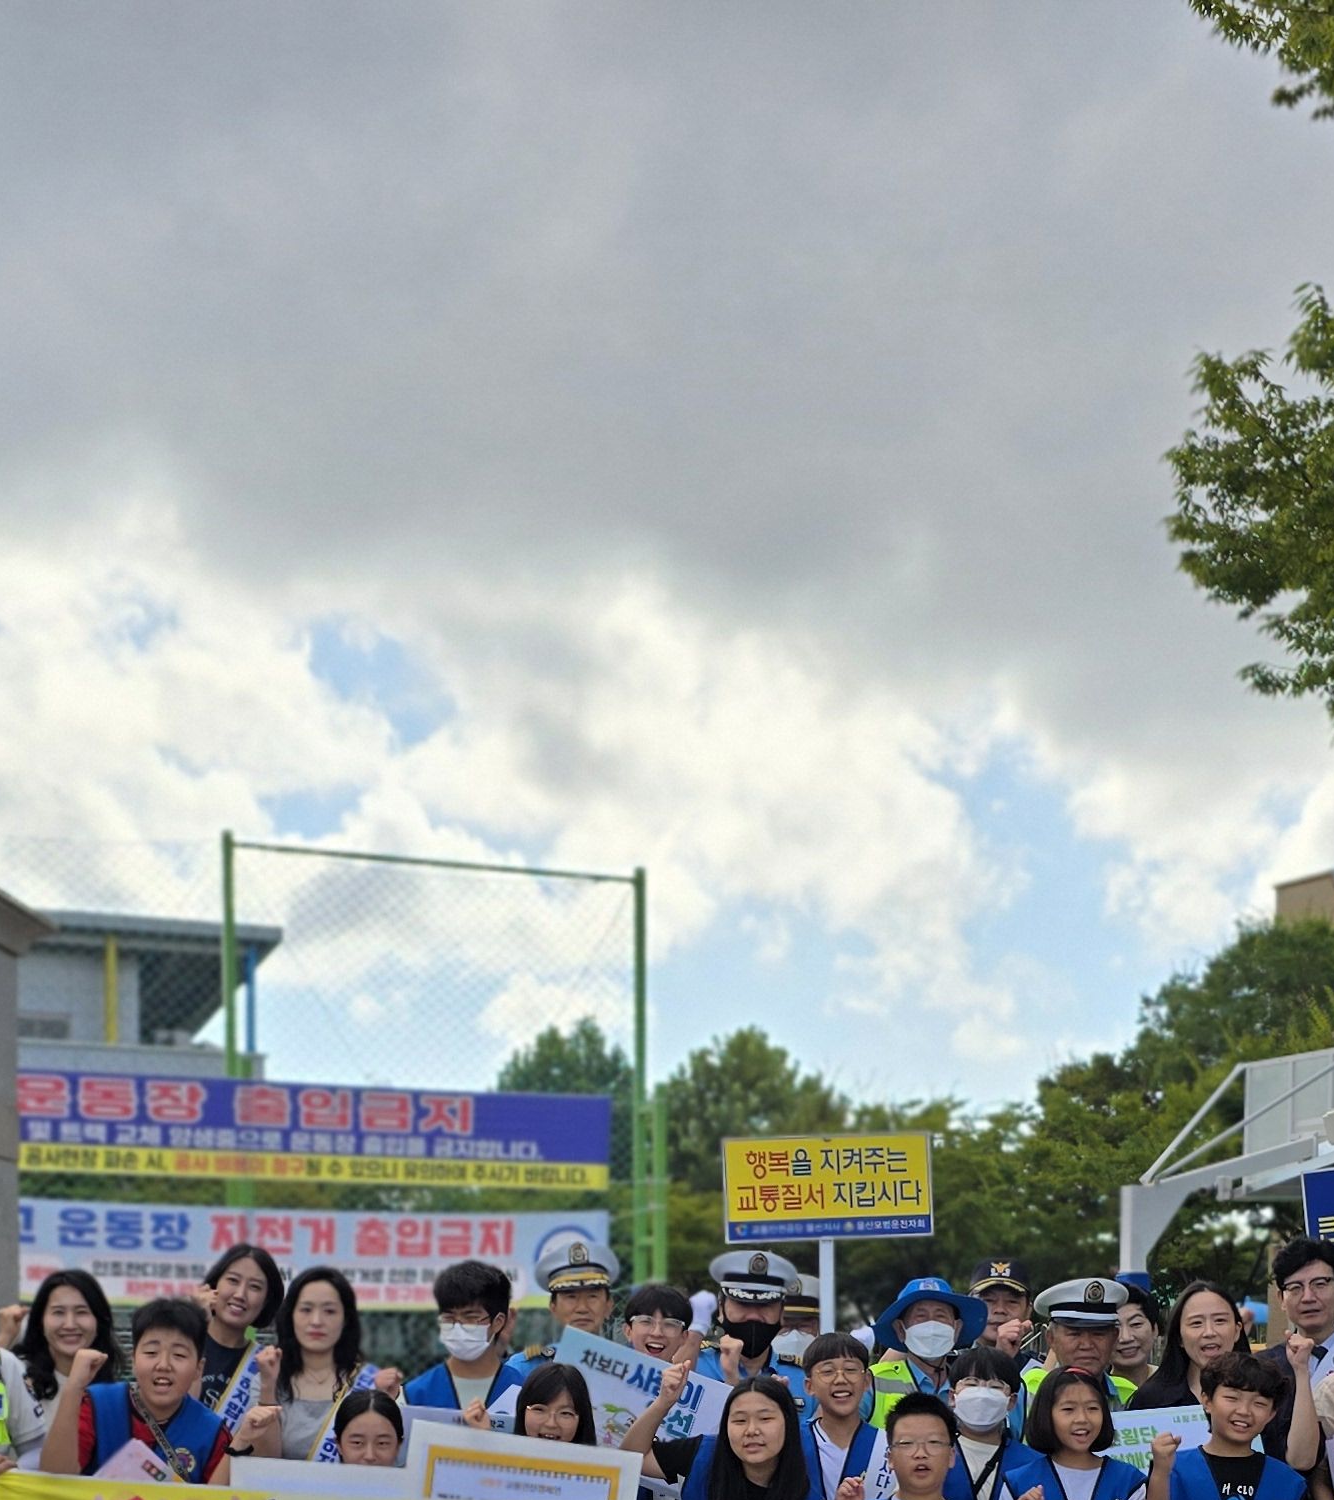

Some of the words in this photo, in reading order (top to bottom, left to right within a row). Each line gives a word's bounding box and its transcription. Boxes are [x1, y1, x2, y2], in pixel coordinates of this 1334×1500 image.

[17, 1075, 206, 1124] 운동장
[233, 1083, 474, 1136] 출입금지
[745, 1148, 812, 1180] 행복을
[820, 1147, 908, 1176] 지켜주는
[737, 1183, 826, 1213] 교통질서
[833, 1180, 922, 1209] 지킵시다
[58, 1207, 191, 1251] 운동장
[210, 1214, 337, 1255] 자전거
[355, 1217, 515, 1258] 출입금지
[580, 1349, 630, 1380] 차보다
[626, 1363, 705, 1413] 사이
[1222, 1483, 1231, 1495] H
